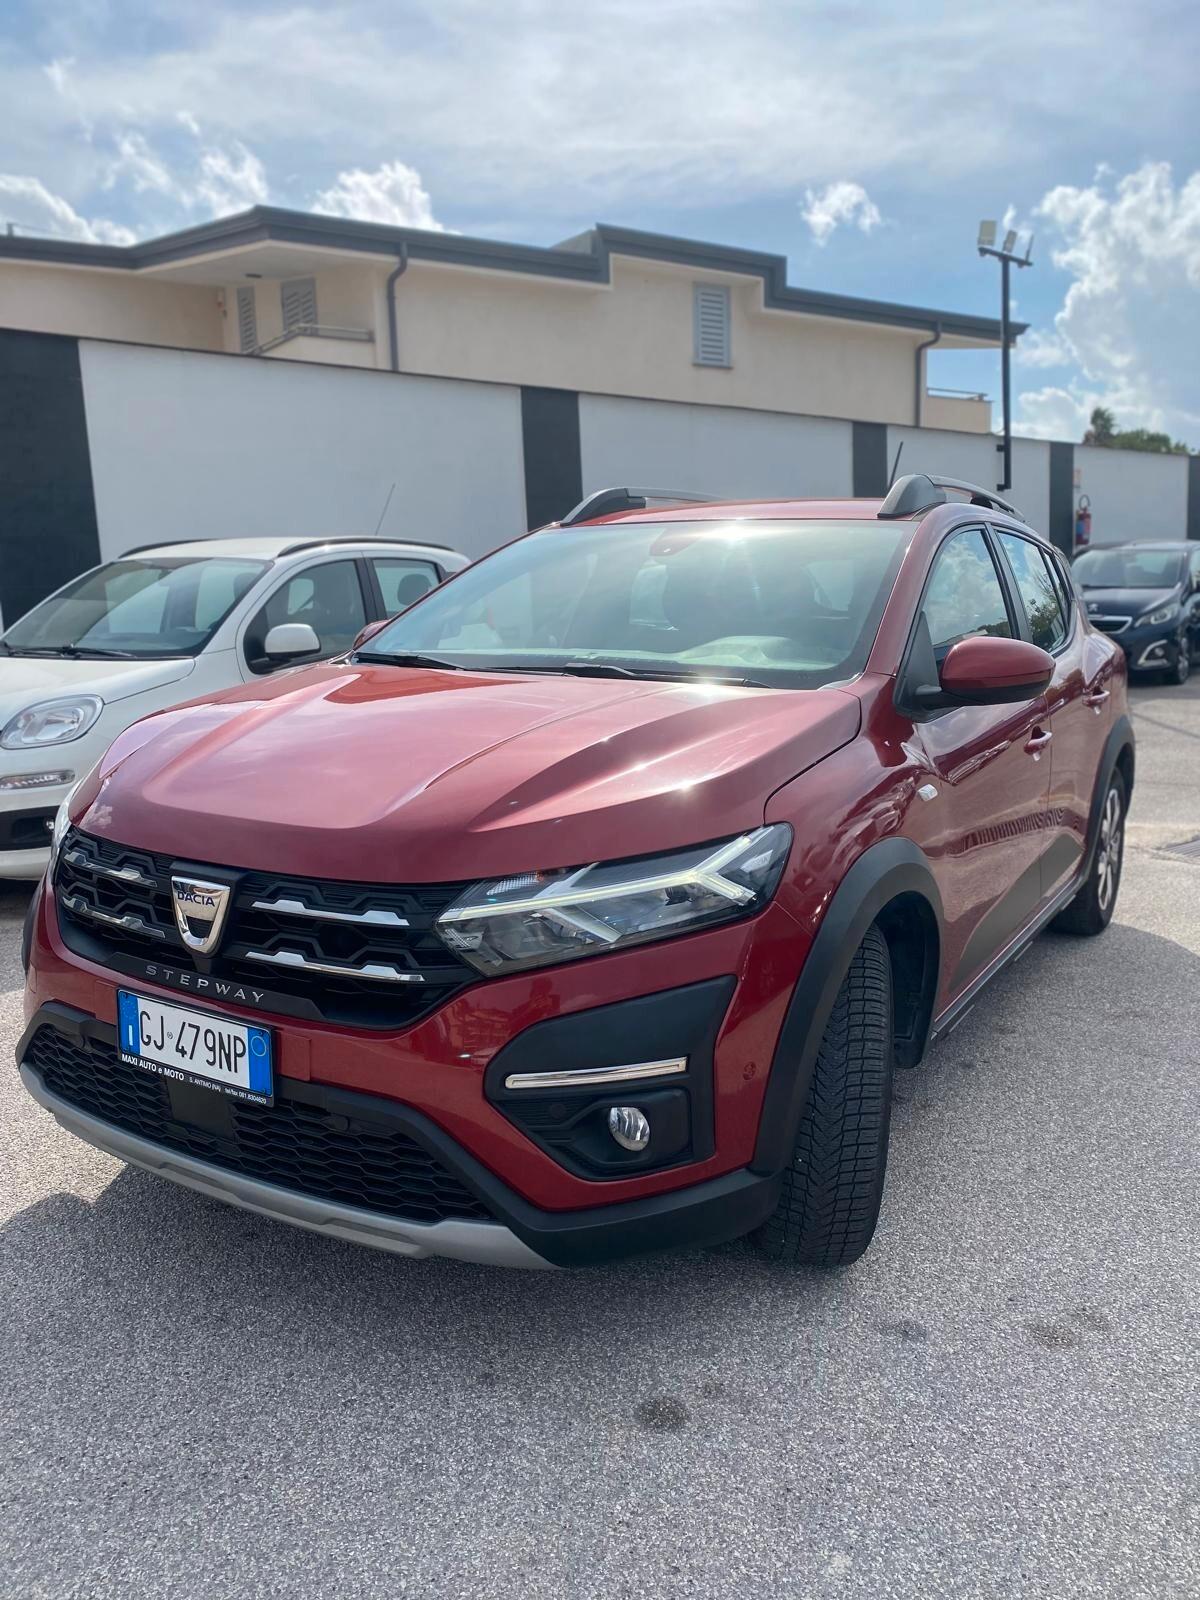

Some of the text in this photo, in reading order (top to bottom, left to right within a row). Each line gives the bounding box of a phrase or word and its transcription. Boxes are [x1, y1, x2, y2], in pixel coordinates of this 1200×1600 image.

[177, 891, 215, 907] DACIA
[145, 965, 264, 1003] STEPWAY
[175, 1021, 247, 1073] 479NP
[121, 1053, 138, 1066] MAXI
[139, 1059, 157, 1072] AUTO
[164, 1067, 185, 1081] MOTO
[194, 1078, 212, 1089] ANTIMO
